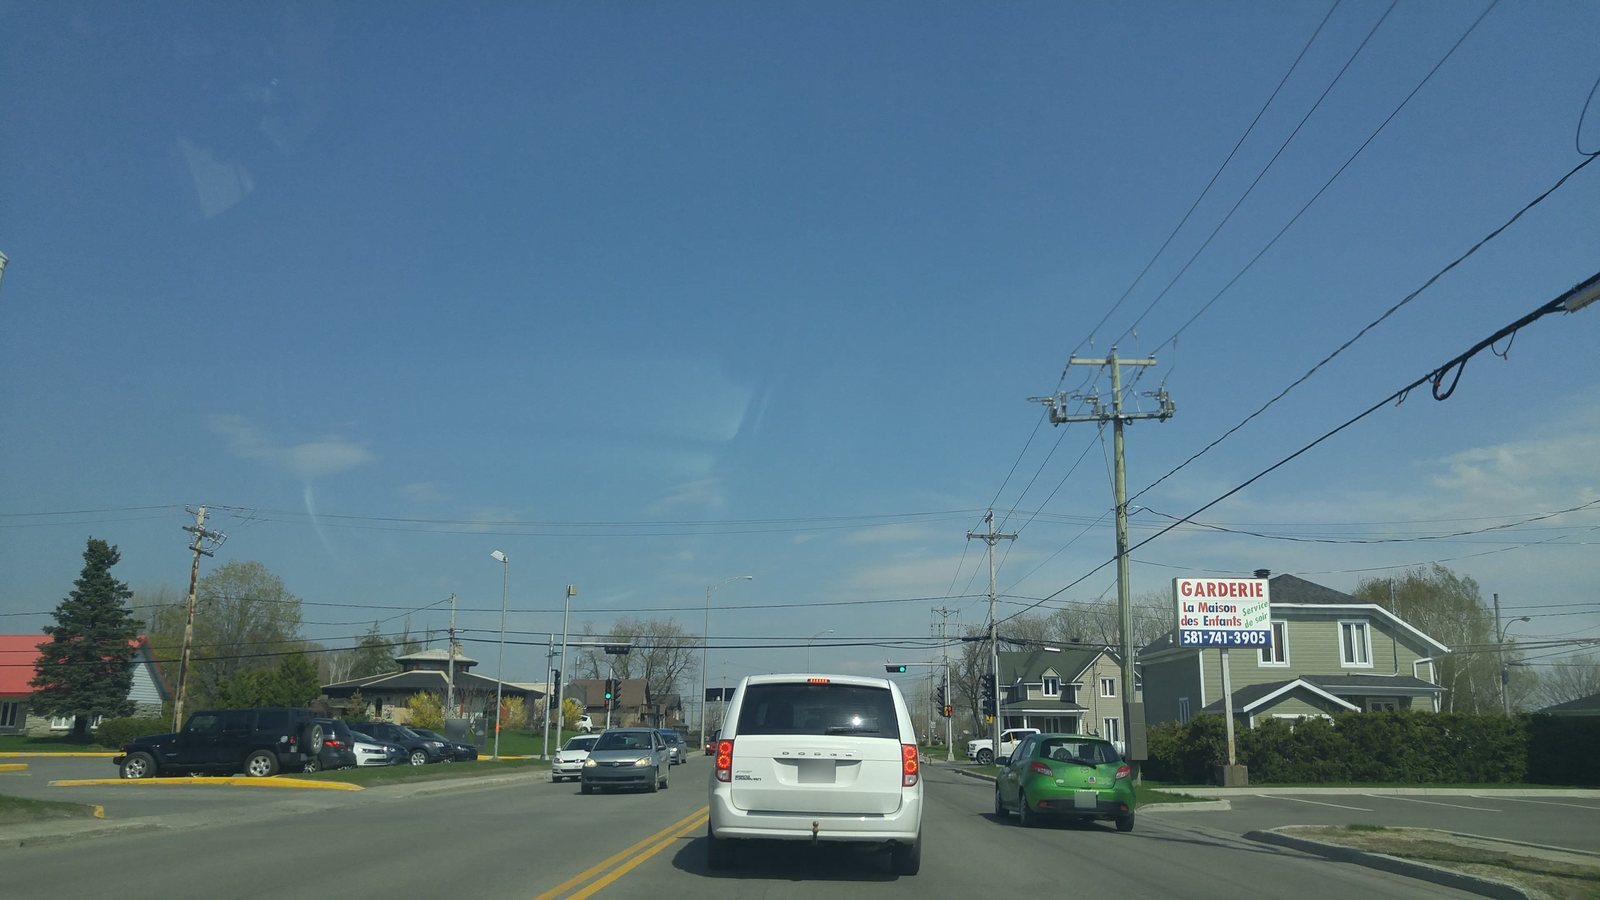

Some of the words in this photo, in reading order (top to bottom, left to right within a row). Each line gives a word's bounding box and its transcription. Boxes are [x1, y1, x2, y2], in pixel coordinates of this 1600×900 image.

[1181, 581, 1263, 598] GARDERIE
[1183, 602, 1194, 613] La
[1198, 602, 1237, 613] Maison
[1242, 601, 1268, 616] Service
[1181, 615, 1199, 626] des
[1203, 615, 1242, 626] Enfants
[1244, 619, 1253, 629] de
[1255, 612, 1268, 624] soir
[1184, 631, 1265, 644] 581-741-3905
